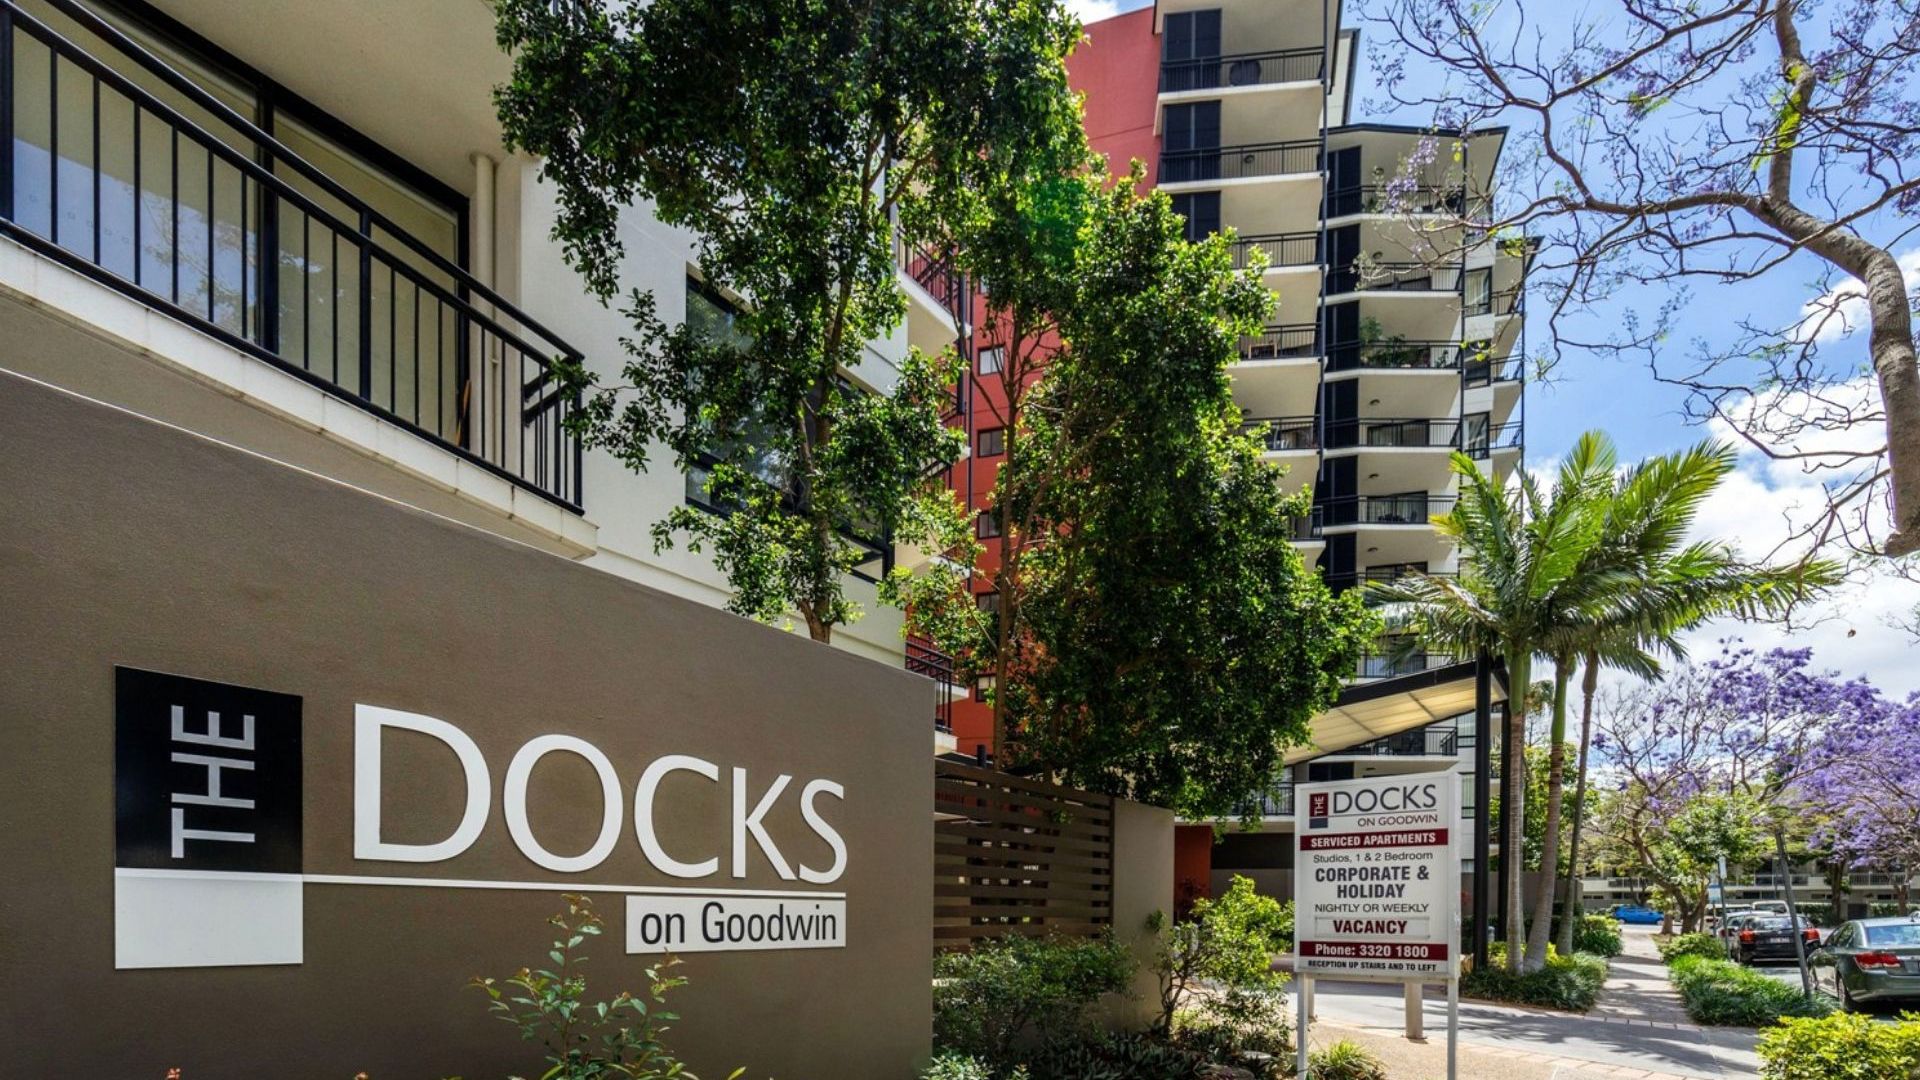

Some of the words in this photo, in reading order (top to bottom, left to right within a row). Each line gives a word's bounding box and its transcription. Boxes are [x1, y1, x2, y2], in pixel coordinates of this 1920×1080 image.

[170, 704, 256, 859] THE
[354, 703, 847, 884] DOCKS
[1333, 784, 1436, 813] DOCKS
[1314, 796, 1324, 816] THE
[1358, 818, 1375, 827] ON
[1378, 814, 1438, 826] GOODWIN
[1311, 836, 1360, 848] SERVICED
[1364, 833, 1436, 844] APARTMENTS
[1314, 854, 1352, 863] Studios,
[1364, 853, 1371, 861] &
[1385, 852, 1433, 860] Bedroom
[1316, 866, 1410, 882] CORPORATE
[1418, 865, 1429, 880] &
[1337, 884, 1405, 898] HOLIDAY
[1315, 904, 1359, 912] NIGHTLY
[1363, 904, 1379, 912] OR
[1382, 904, 1428, 912] WEEKLY
[640, 908, 685, 945] on
[700, 901, 837, 944] Goodwin
[1333, 920, 1407, 934] VACANCY
[1315, 944, 1356, 956] Phone:
[1360, 945, 1390, 956] 3320
[1398, 946, 1428, 957] 1800
[1308, 960, 1347, 968] RECEPTION
